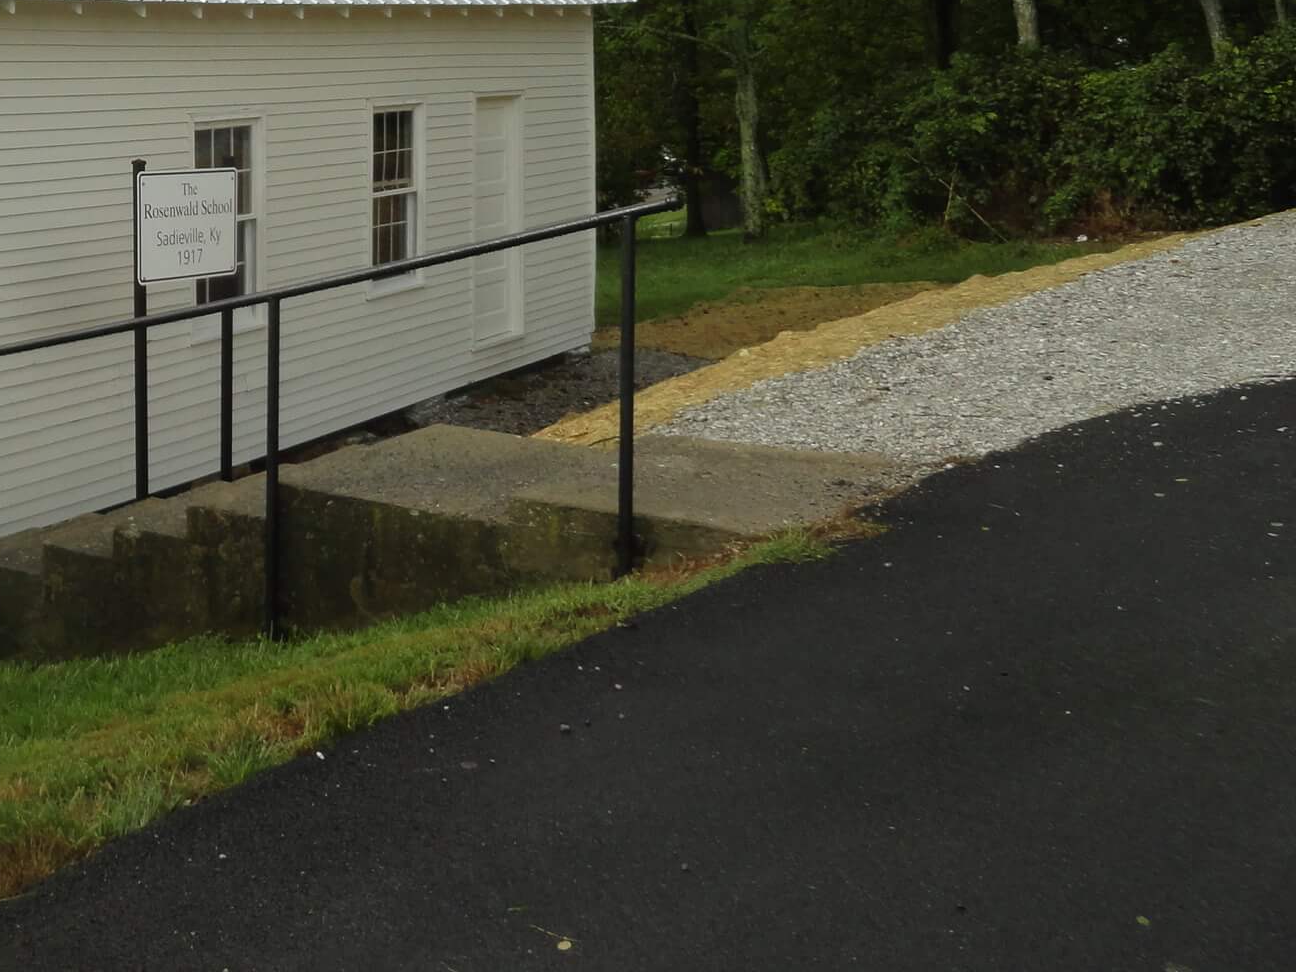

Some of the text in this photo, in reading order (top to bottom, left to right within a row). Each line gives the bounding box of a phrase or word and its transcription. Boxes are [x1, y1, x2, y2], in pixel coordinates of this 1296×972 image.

[181, 183, 198, 196] The
[144, 198, 232, 219] Rosenwald School
[156, 226, 221, 247] Sadieville, Ky
[177, 248, 203, 266] 1917
